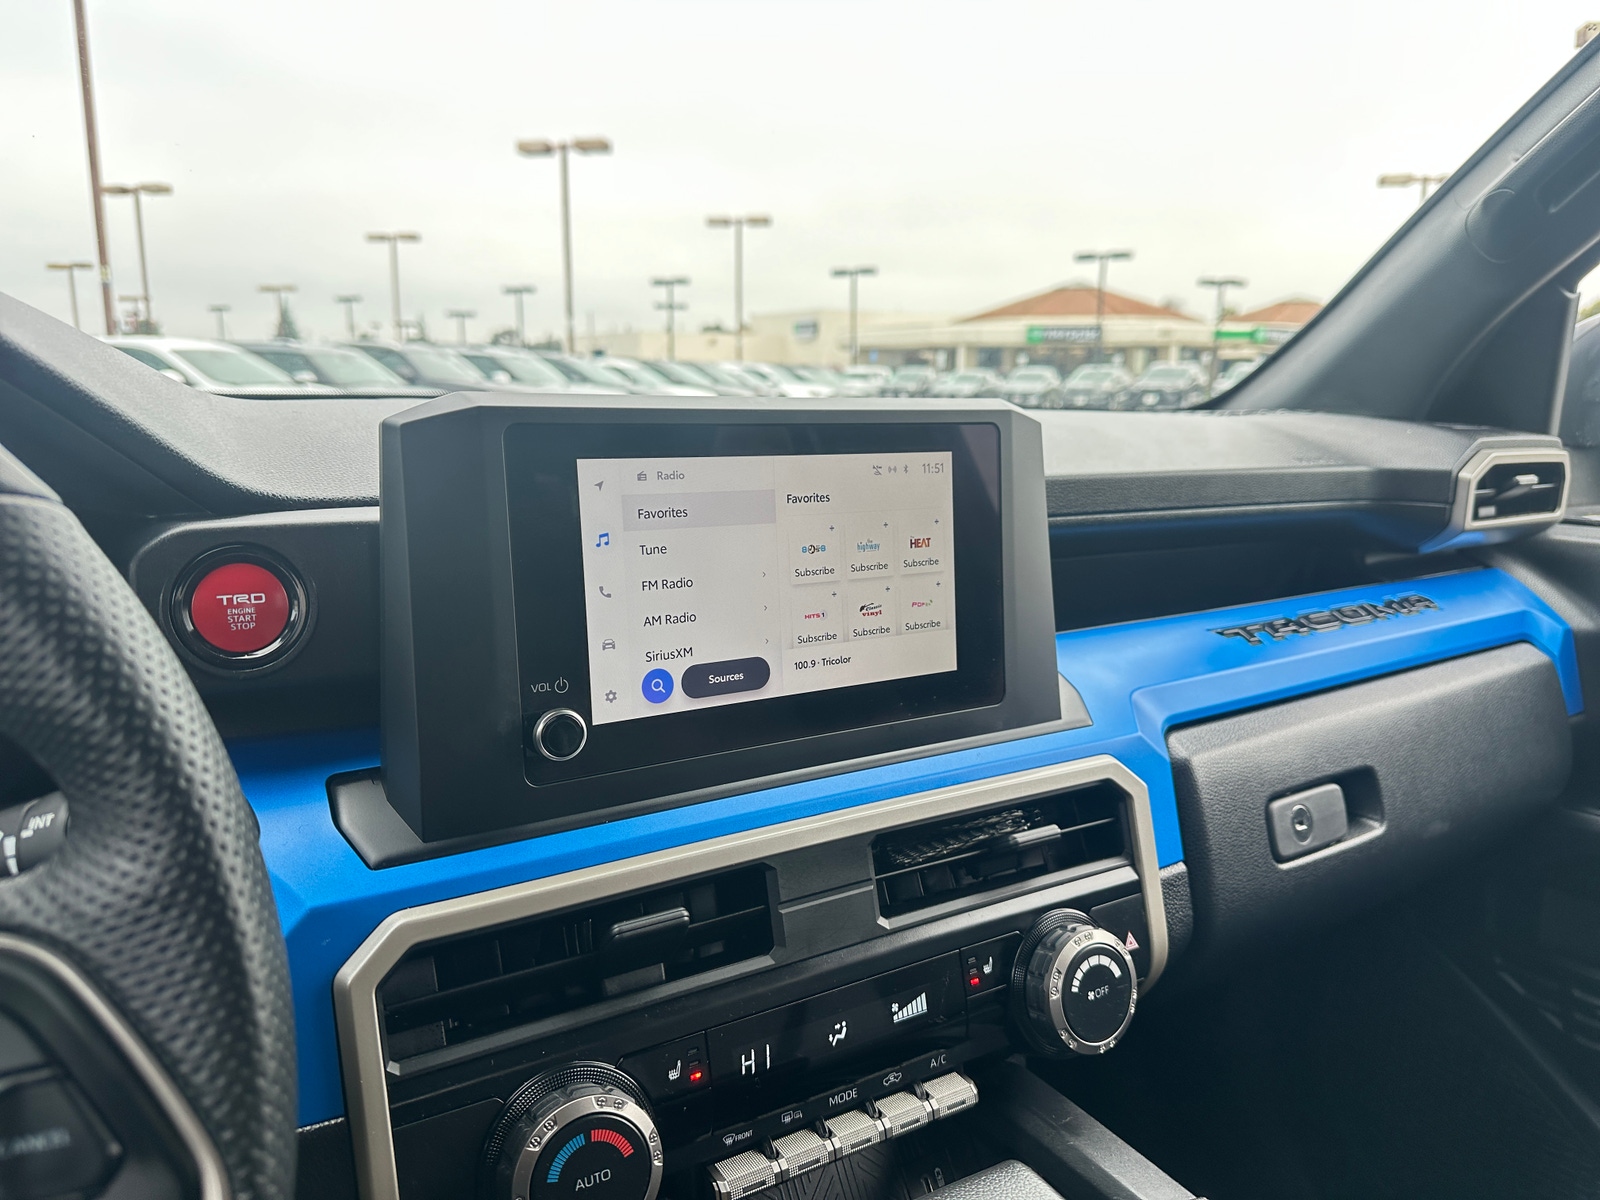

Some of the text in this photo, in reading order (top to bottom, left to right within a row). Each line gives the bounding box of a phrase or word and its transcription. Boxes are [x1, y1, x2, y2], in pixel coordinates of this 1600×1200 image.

[922, 463, 944, 474] 11:51
[656, 471, 685, 481] Radio
[786, 492, 830, 504] Favorites
[637, 507, 688, 520] Favorites
[639, 544, 667, 555] Tune
[910, 538, 931, 549] HEAT
[850, 562, 888, 572] Subscribe
[903, 557, 939, 568] Subscribe
[794, 566, 835, 577] Subscribe
[642, 578, 694, 591] FM Radio
[216, 593, 266, 606] TRD
[227, 614, 256, 623] START
[643, 612, 697, 627] AM Radio
[1212, 594, 1439, 645] TACOMA
[231, 622, 256, 631] STOP
[905, 619, 941, 631] Subscribe
[853, 626, 891, 637] Subscribe
[797, 632, 837, 644] Subscribe
[645, 647, 693, 662] SiriusXM
[794, 655, 851, 670] 100.9 Tricolor
[708, 672, 744, 684] Sources
[531, 683, 551, 692] VOL
[28, 812, 55, 830] INT
[1094, 985, 1110, 998] OFF
[930, 1054, 947, 1069] A/C
[828, 1088, 858, 1107] MODE
[735, 1129, 753, 1142] FRONT
[575, 1168, 611, 1192] AUTO
